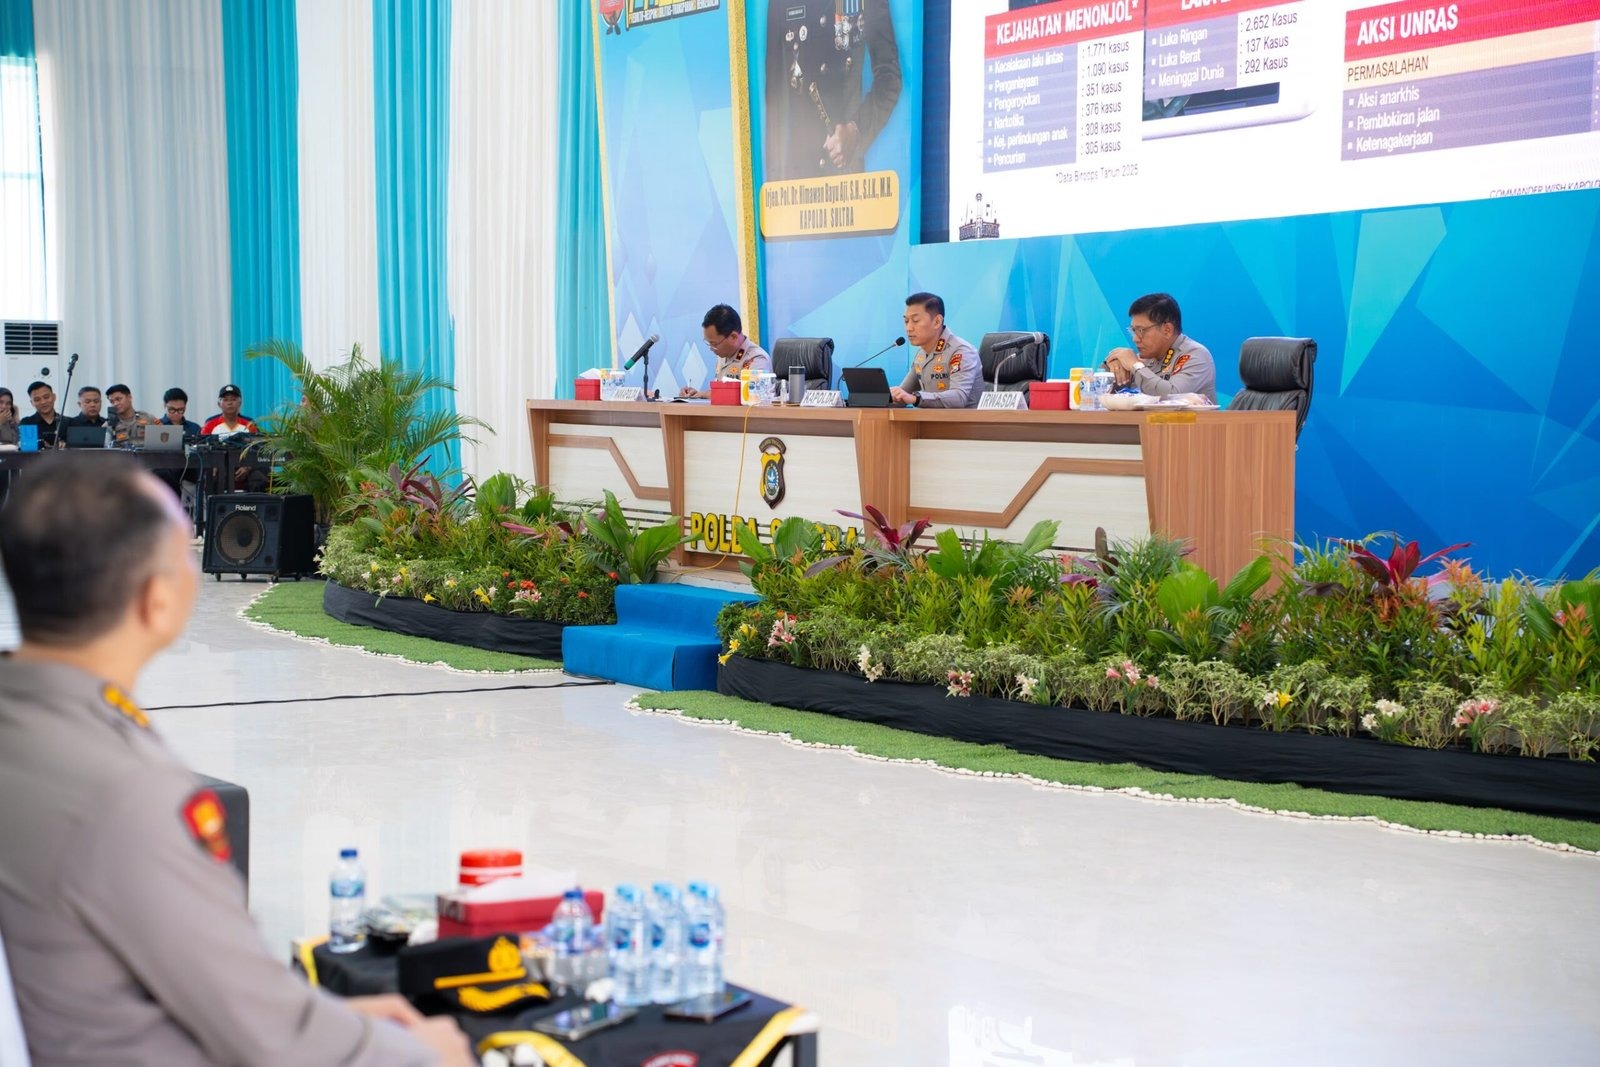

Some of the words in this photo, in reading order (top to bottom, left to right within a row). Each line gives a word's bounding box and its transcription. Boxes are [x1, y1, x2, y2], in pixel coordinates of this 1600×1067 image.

[997, 13, 1061, 45] KEJAHATAN
[1159, 32, 1178, 47] Luka
[1180, 28, 1207, 44] Ringan
[1246, 15, 1269, 32] 2.652
[1272, 12, 1297, 28] Kasus
[1357, 16, 1395, 46] AKSI
[1400, 4, 1458, 38] UNRAS
[1032, 53, 1044, 67] lalu
[1046, 51, 1064, 65] lintas
[1087, 43, 1106, 57] 1.771
[1108, 40, 1129, 54] kasus
[1159, 53, 1177, 67] Luka
[1180, 50, 1201, 64] Berat
[1246, 38, 1261, 52] 137
[1264, 36, 1289, 50] Kasus
[1087, 63, 1106, 77] 1.090
[1108, 61, 1129, 74] kasus
[1159, 69, 1198, 87] Meninggal
[1202, 64, 1224, 81] Dunia
[1245, 59, 1260, 74] 292
[1263, 56, 1288, 70] Kasus
[1348, 55, 1429, 82] PERMASALAHAN
[1086, 84, 1099, 96] 351
[1102, 80, 1122, 94] kasus
[1357, 91, 1378, 108] Aksi
[1380, 85, 1420, 105] anarkhis
[994, 113, 1024, 129] Narkotika
[1086, 103, 1099, 117] 376
[1101, 101, 1121, 114] kasus
[1357, 111, 1415, 131] Pemblokiran
[1416, 106, 1440, 127] jalan
[1007, 130, 1050, 149] perlindungan
[1052, 126, 1068, 141] anak
[1085, 122, 1099, 136] 308
[1101, 120, 1121, 133] kasus
[1357, 131, 1433, 153] Ketenagakerjaan
[994, 151, 1026, 166] Pencurian
[1085, 141, 1098, 155] 305
[1101, 139, 1121, 152] kasus
[800, 208, 827, 230] KAPOLDA
[831, 206, 854, 228] SULTRA
[980, 392, 1018, 408] IRWASDA
